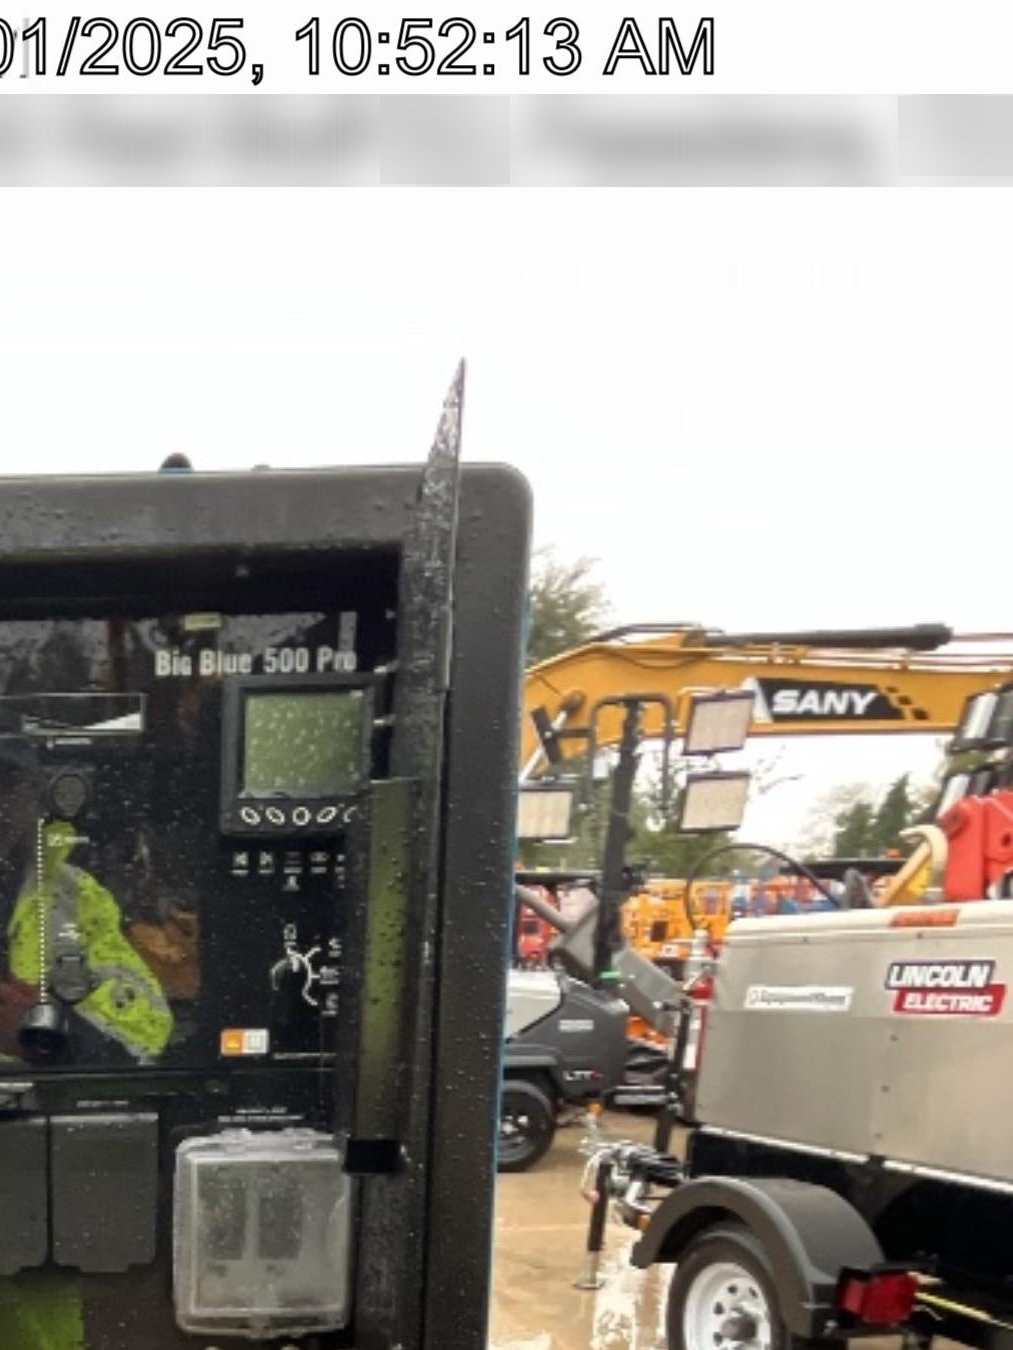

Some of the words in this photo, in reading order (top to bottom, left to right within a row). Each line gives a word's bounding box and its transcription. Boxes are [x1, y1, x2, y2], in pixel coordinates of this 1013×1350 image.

[199, 650, 252, 676] Blue
[263, 647, 310, 674] 500
[316, 646, 357, 672] Pro
[772, 688, 877, 715] SANY
[890, 965, 989, 987] LINCOLN
[902, 992, 994, 1012] ELECTRIC
